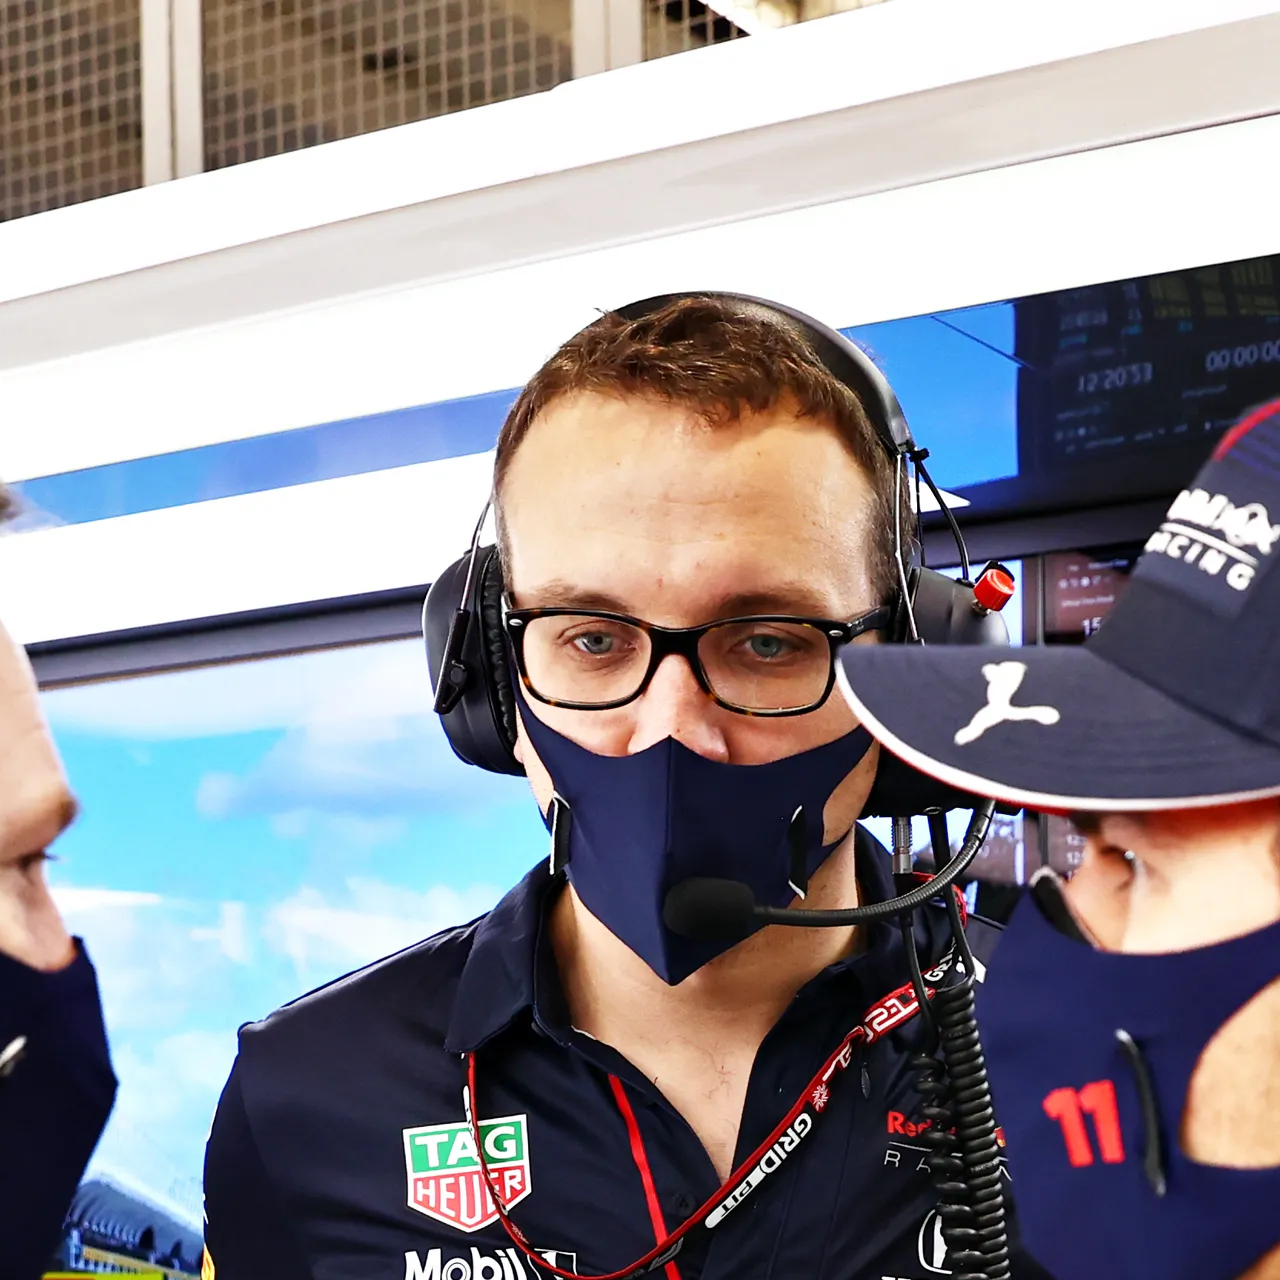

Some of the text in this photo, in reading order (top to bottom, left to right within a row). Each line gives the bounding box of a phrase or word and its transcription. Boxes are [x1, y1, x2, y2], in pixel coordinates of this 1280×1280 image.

[415, 1125, 517, 1169] TAG
[758, 1111, 813, 1174] GRID
[1042, 1079, 1127, 1169] 11
[415, 1168, 524, 1223] HEUER
[719, 1178, 754, 1219] PIT
